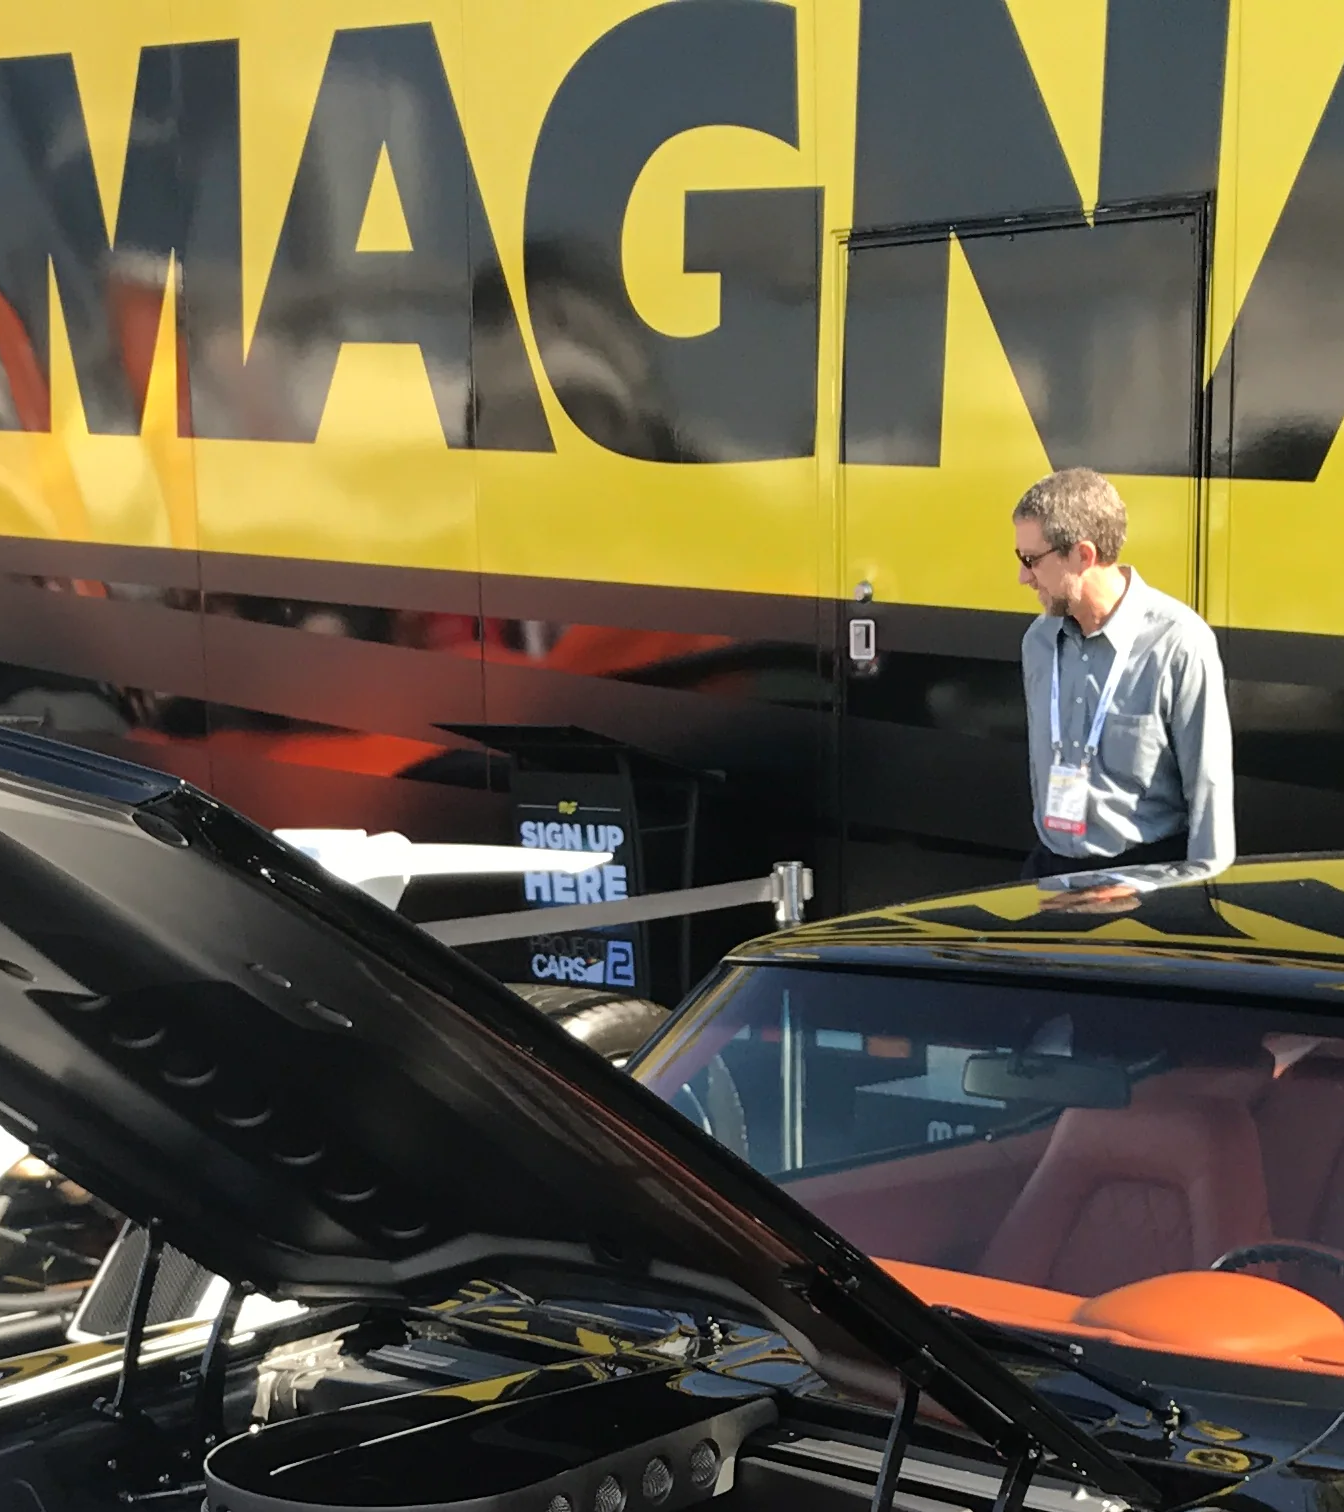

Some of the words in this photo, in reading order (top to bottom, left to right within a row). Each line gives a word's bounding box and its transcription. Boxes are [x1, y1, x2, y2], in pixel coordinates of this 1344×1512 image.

[520, 820, 582, 850] SIGN
[586, 824, 624, 853] UP
[523, 864, 629, 905] HERE
[531, 953, 587, 982] CARS
